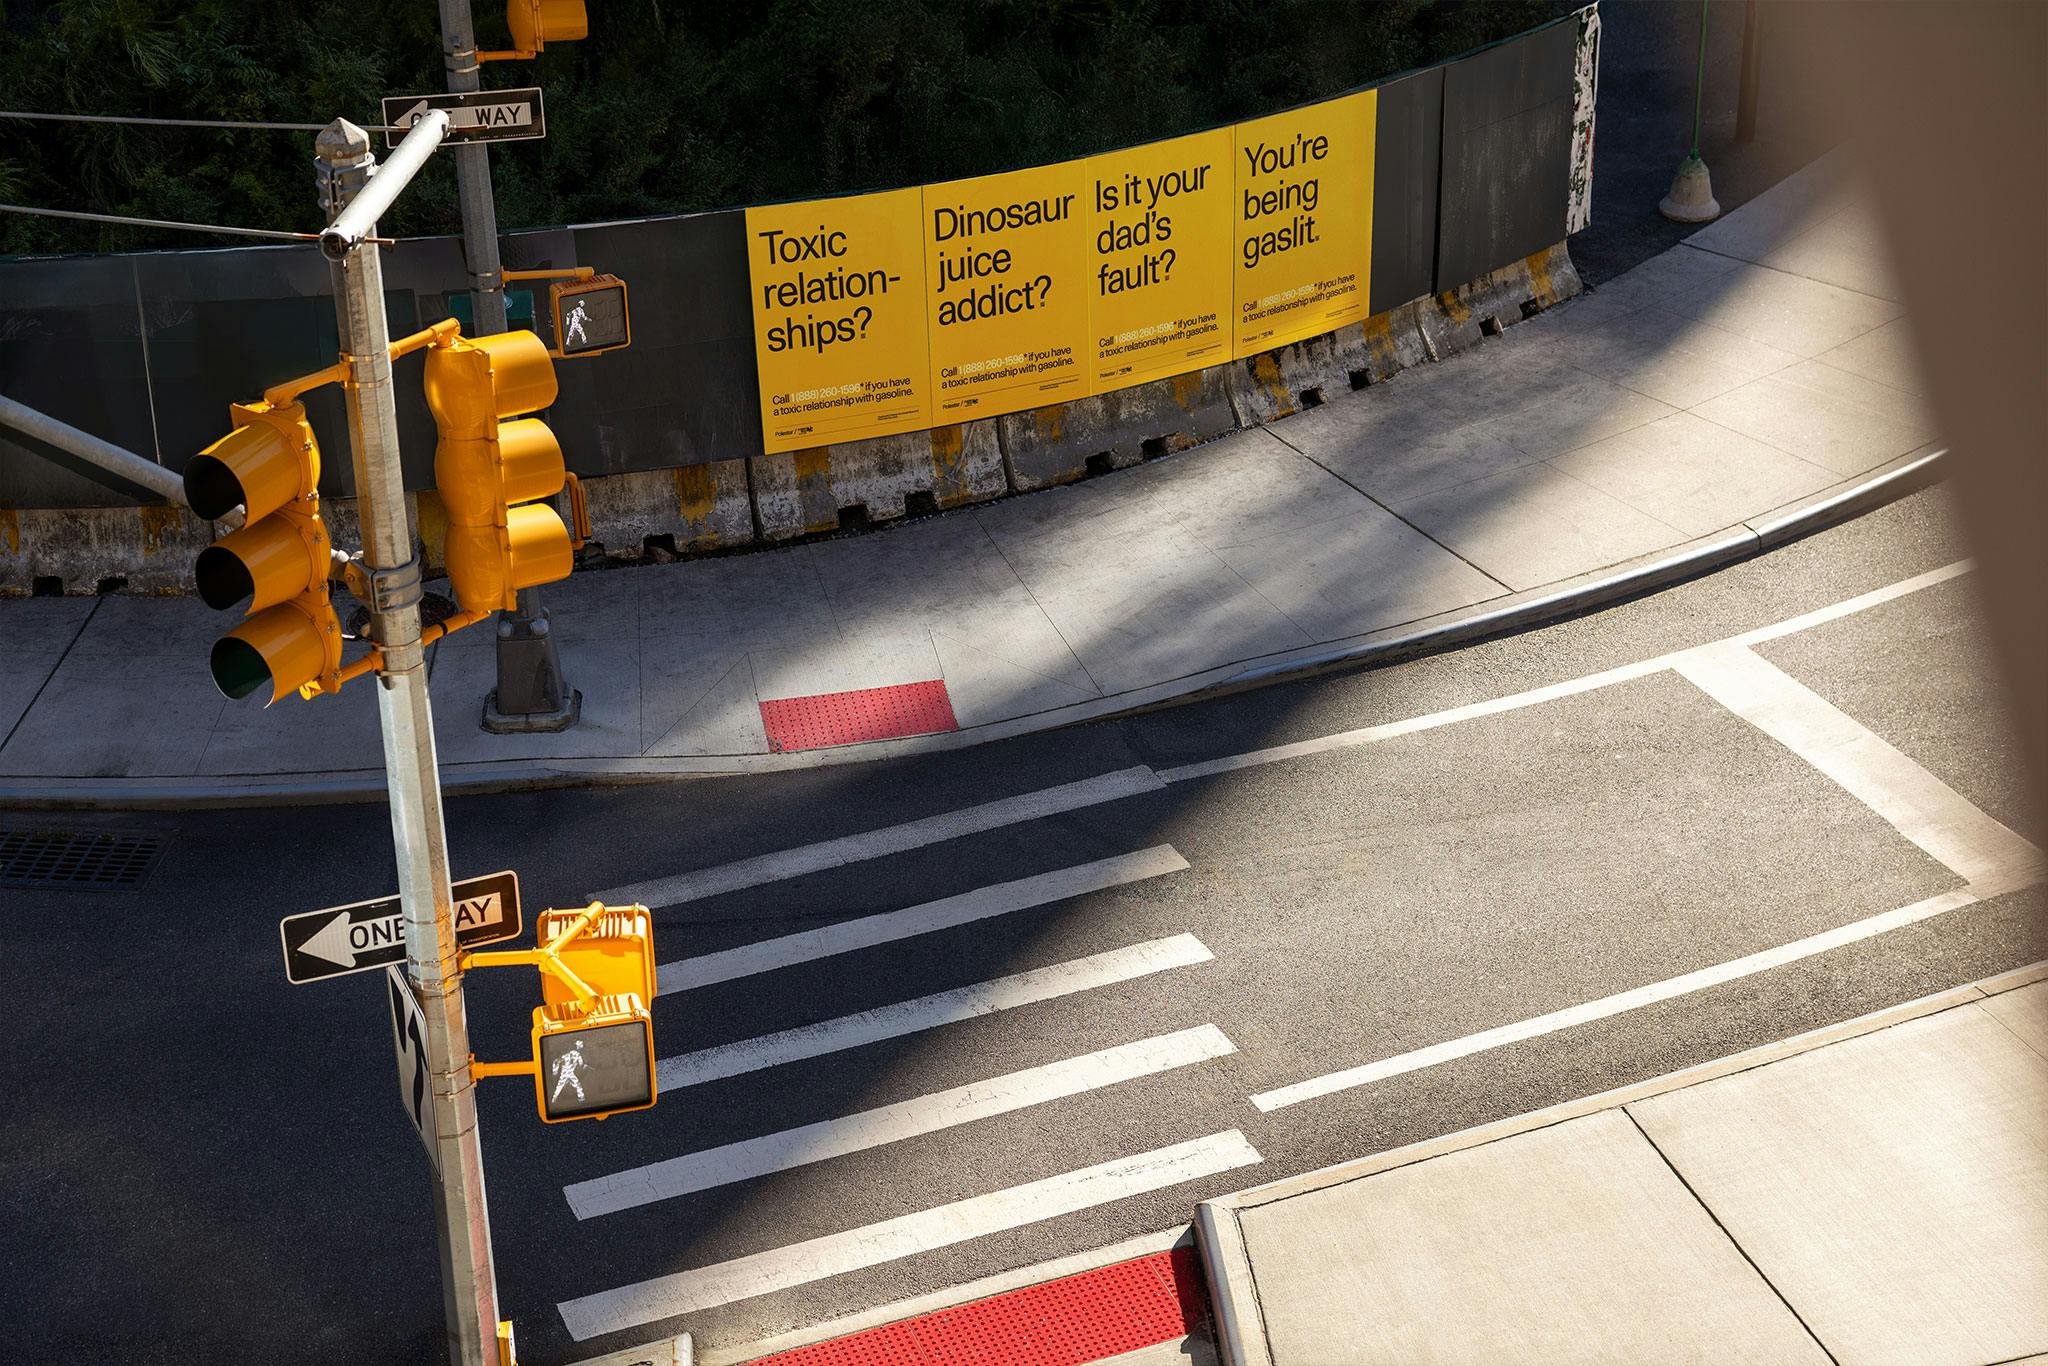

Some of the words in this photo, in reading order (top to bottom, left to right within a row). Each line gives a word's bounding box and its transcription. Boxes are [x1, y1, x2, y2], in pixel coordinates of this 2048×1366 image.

[475, 106, 521, 125] WAY
[1244, 133, 1329, 177] You’re
[1096, 180, 1119, 213] Is
[1125, 174, 1142, 206] it
[1146, 164, 1211, 210] your
[1244, 179, 1319, 221] being
[934, 194, 1075, 242] Dinosaur
[1097, 211, 1172, 255] dad’s
[758, 225, 847, 264] Toxic
[1243, 215, 1320, 269] gaslit.
[764, 267, 900, 309] relation-
[937, 247, 1012, 293] juice
[1097, 248, 1176, 296] fault?
[938, 275, 1052, 326] addict?
[1242, 300, 1258, 313] Call
[1318, 281, 1324, 290] if
[1323, 279, 1337, 291] you
[1337, 273, 1356, 285] have
[1242, 315, 1248, 323] a
[1248, 309, 1266, 322] toxic
[1266, 297, 1309, 316] relationship
[1308, 291, 1325, 303] with
[1325, 284, 1357, 300] gasoline.
[767, 306, 873, 354] ships?
[1099, 336, 1114, 348] Call
[1177, 319, 1184, 328] if
[1183, 319, 1198, 330] you
[1198, 313, 1217, 324] have
[1099, 351, 1105, 359] a
[1105, 346, 1124, 358] toxic
[1124, 336, 1169, 352] relationship
[1169, 330, 1185, 341] with
[1186, 323, 1219, 340] gasoline.
[941, 367, 958, 378] Call
[1028, 352, 1035, 361] if
[1034, 350, 1050, 362] you
[1051, 346, 1072, 357] have
[941, 381, 948, 389] a
[948, 376, 970, 388] toxic
[969, 368, 1018, 385] relationship
[1018, 363, 1037, 374] with
[1038, 357, 1075, 373] gasoline.
[772, 394, 790, 405] Call
[865, 380, 872, 391] if
[872, 380, 889, 393] you
[889, 377, 911, 388] have
[773, 408, 779, 416] a
[780, 403, 802, 415] toxic
[802, 396, 855, 412] relationship
[855, 392, 875, 404] with
[875, 387, 914, 402] gasoline.
[350, 918, 405, 950] ONE
[455, 897, 492, 928] AY
